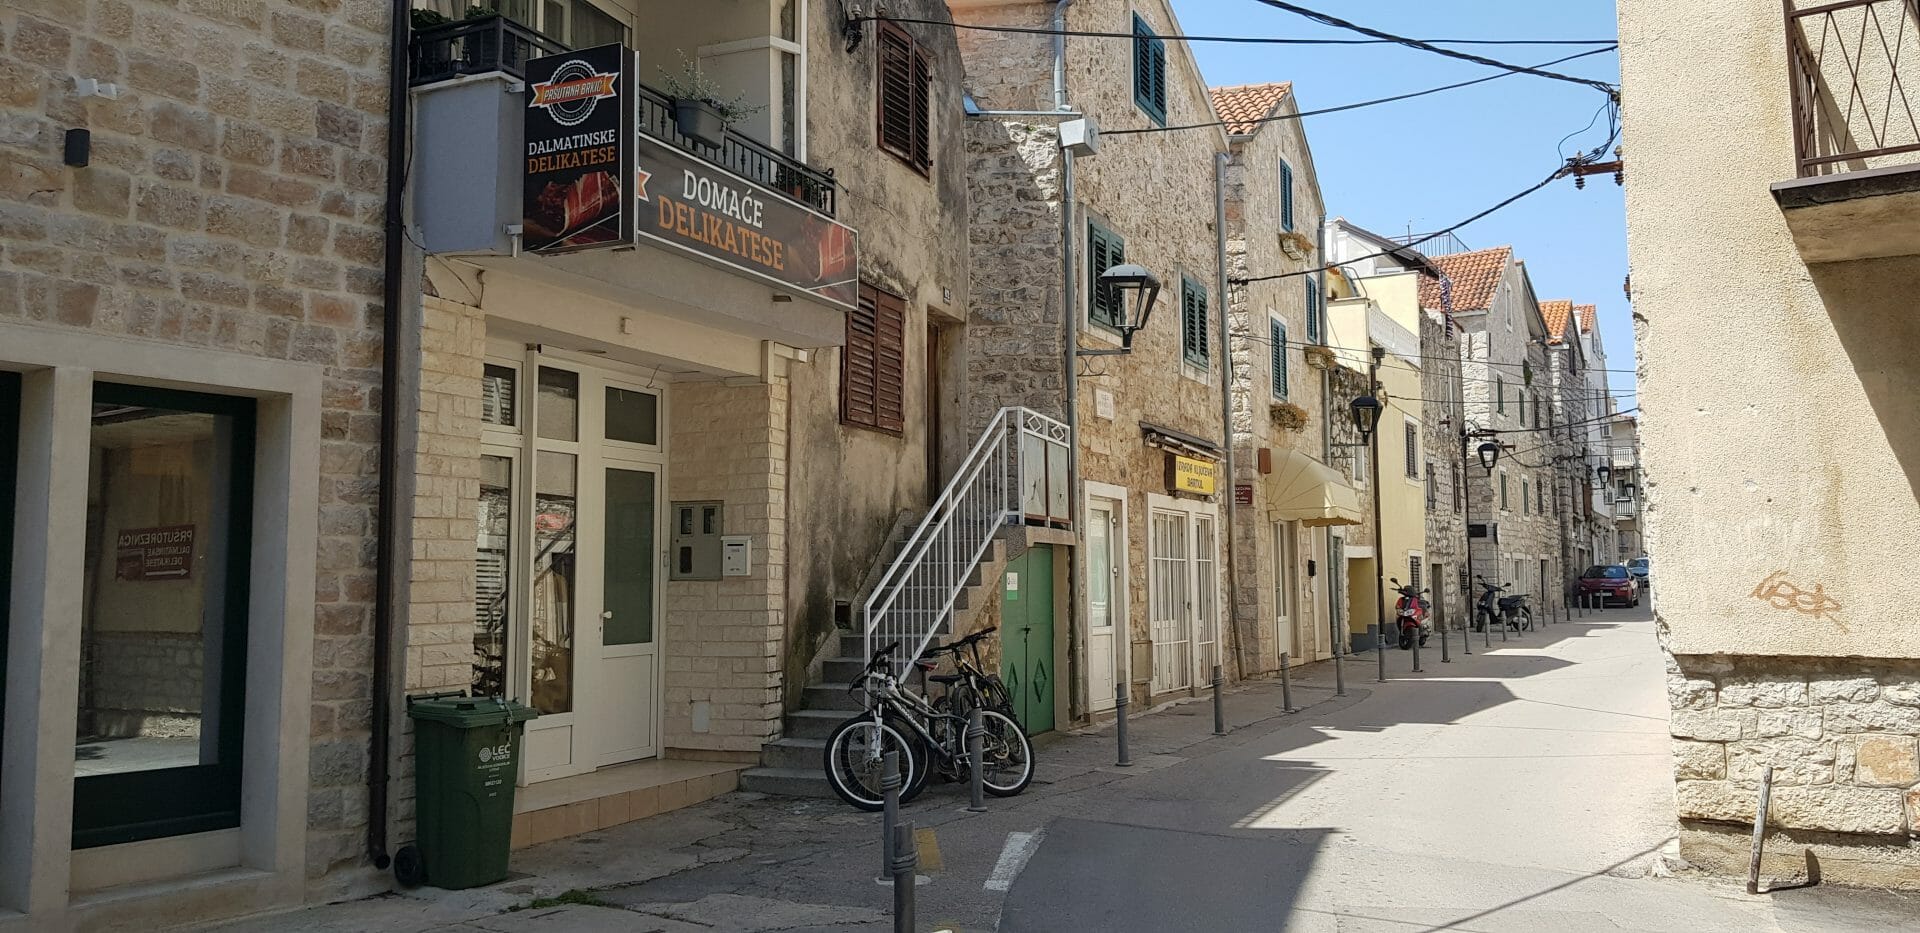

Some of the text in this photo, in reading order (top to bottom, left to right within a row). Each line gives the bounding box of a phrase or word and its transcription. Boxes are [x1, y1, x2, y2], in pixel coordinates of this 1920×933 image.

[543, 86, 580, 101] PRŠUTANA
[528, 129, 616, 156] DALMATINSKE
[528, 146, 616, 174] DELIKATESE
[683, 169, 763, 228] DOMAĆE
[658, 195, 784, 271] DELIKATESE
